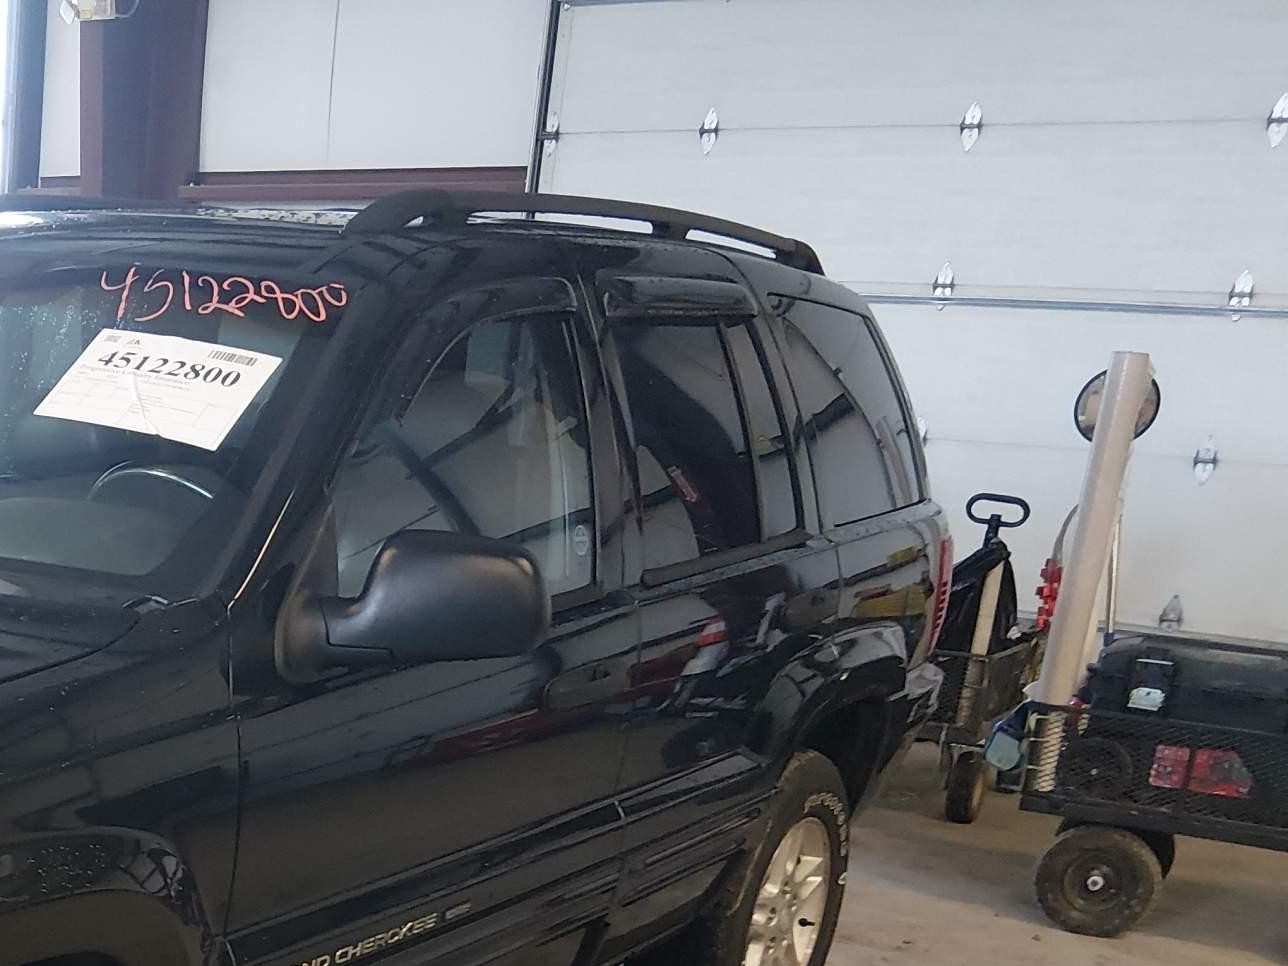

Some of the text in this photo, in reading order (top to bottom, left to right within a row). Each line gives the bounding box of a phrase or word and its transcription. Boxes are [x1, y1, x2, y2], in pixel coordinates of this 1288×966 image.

[100, 266, 348, 322] 45122800
[98, 351, 242, 388] 45122800
[334, 912, 439, 965] CHEROKEE
